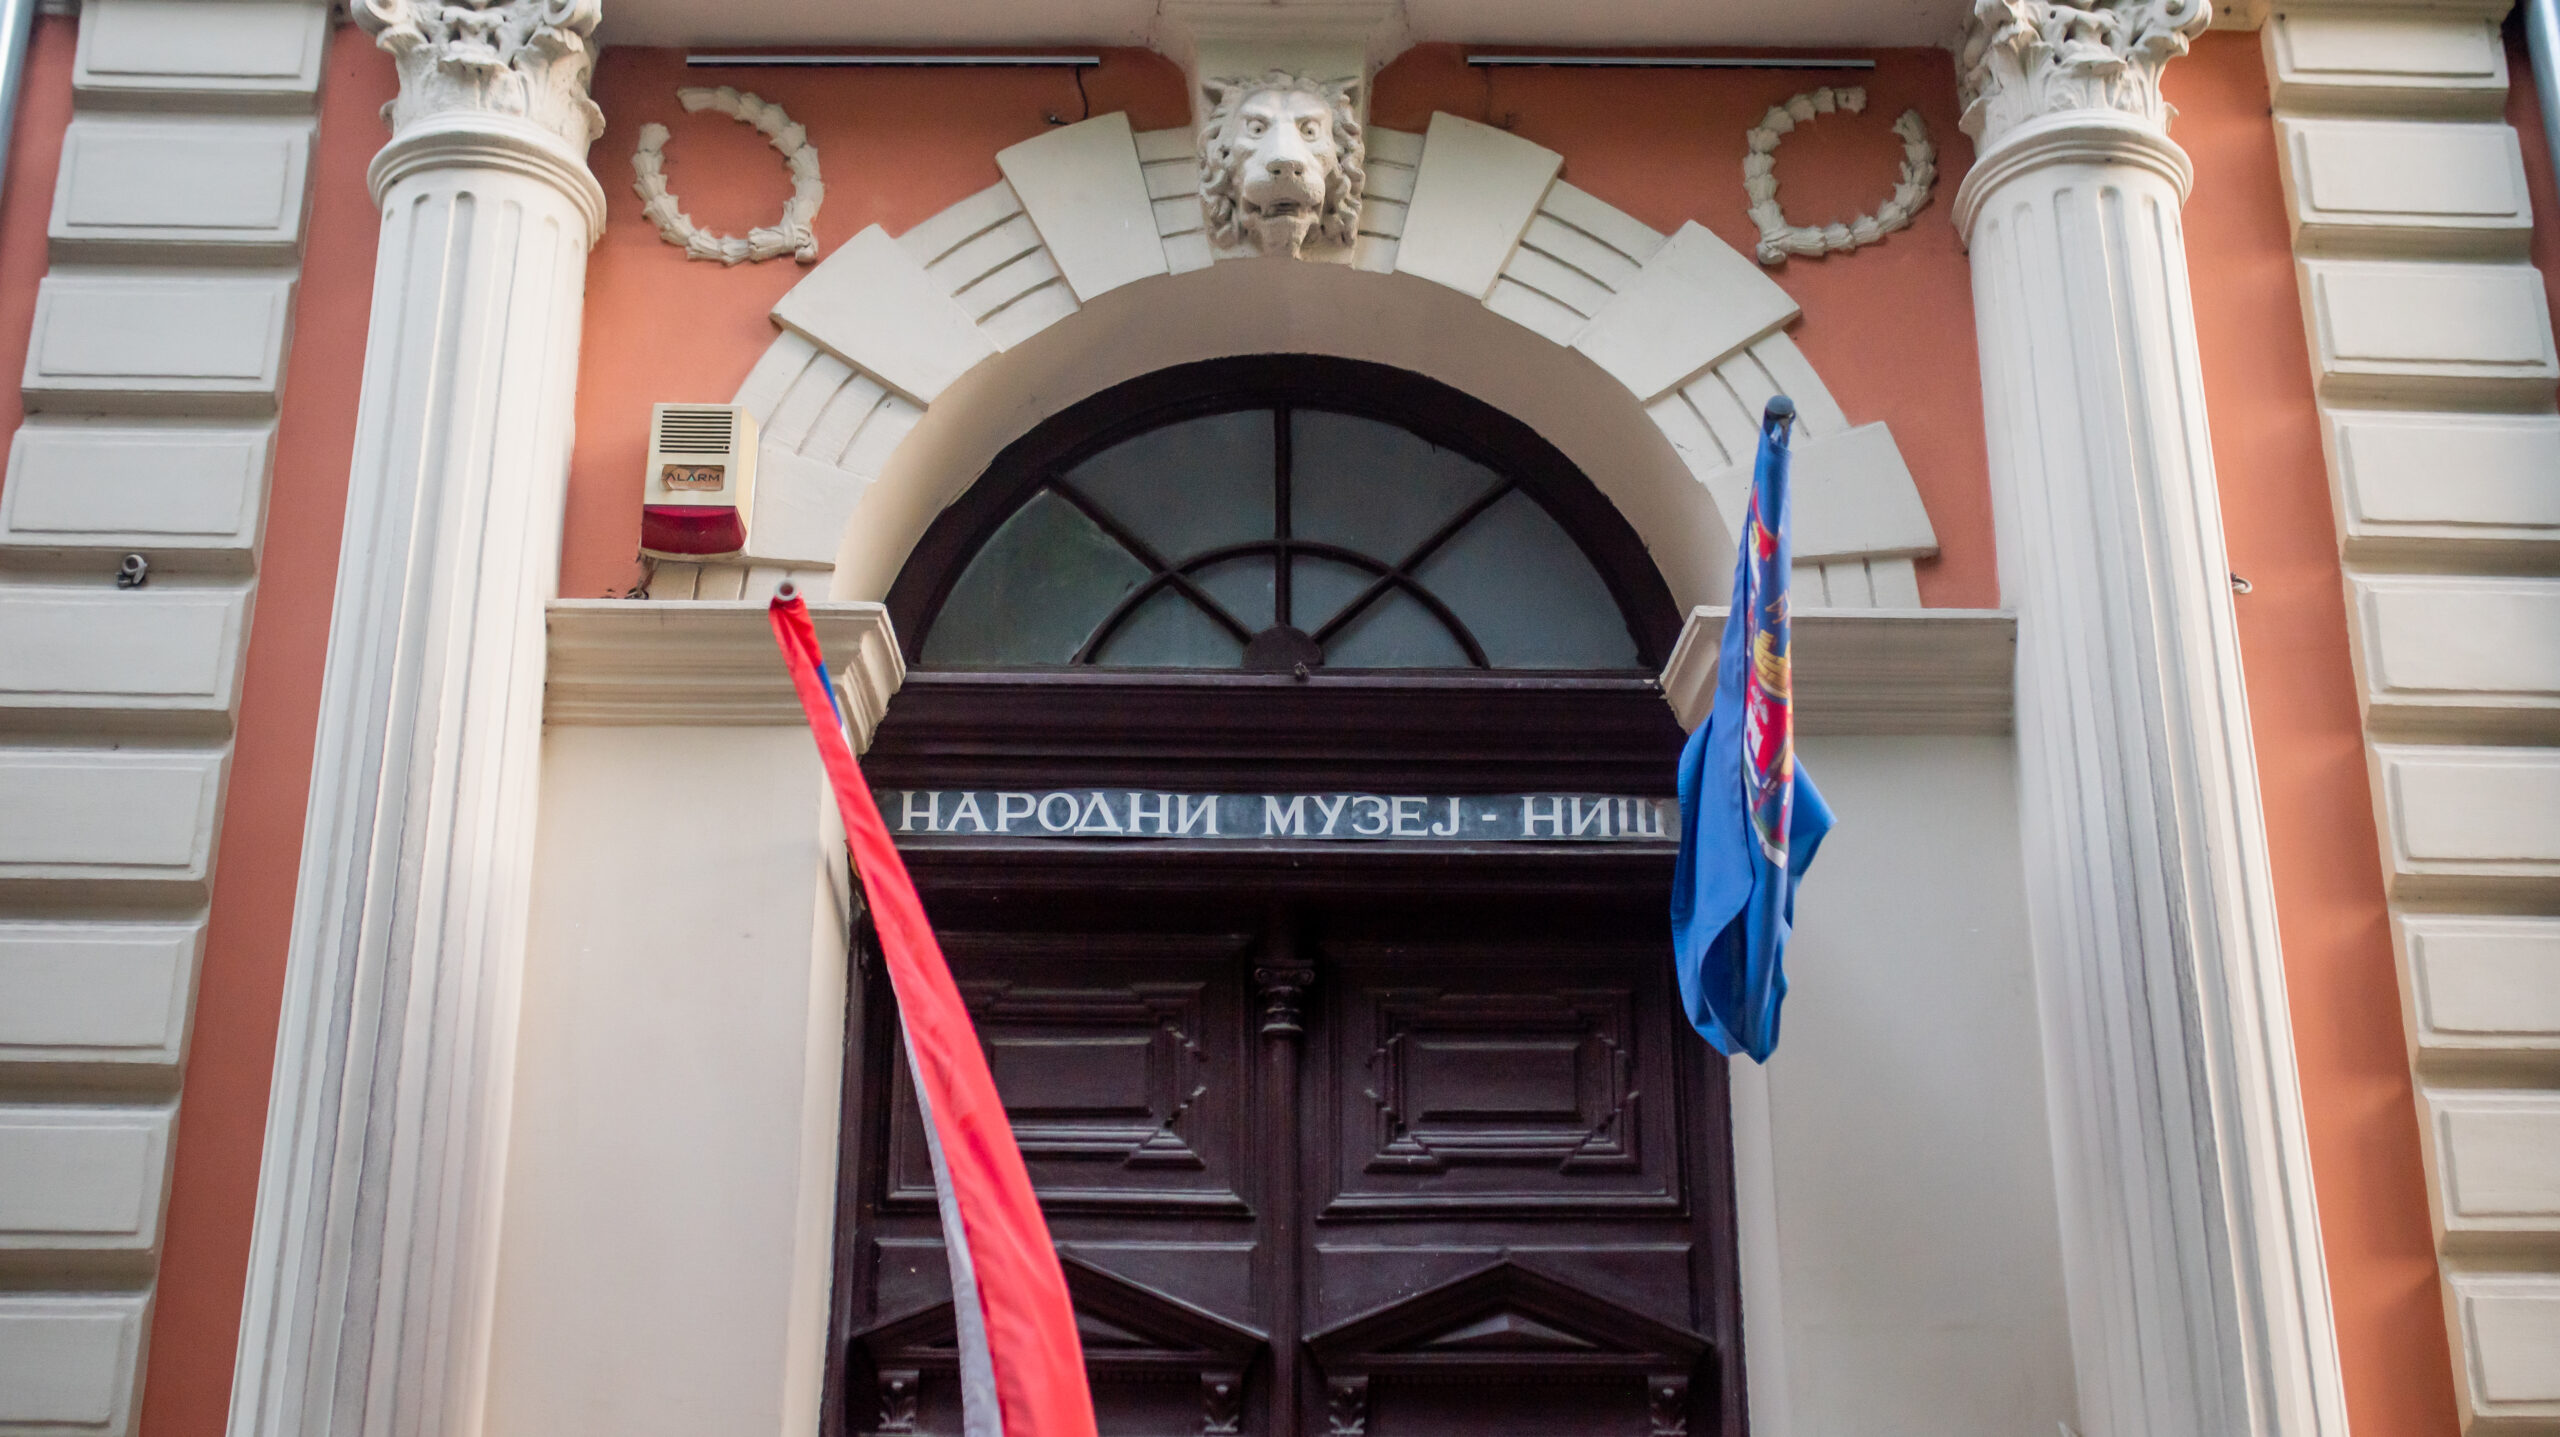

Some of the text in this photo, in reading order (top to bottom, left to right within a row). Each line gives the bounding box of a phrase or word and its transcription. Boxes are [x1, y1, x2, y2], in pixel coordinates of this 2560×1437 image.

[665, 472, 720, 482] ALARM
[897, 791, 1222, 836] НАРОДНИ
[1262, 794, 1461, 836] МУЗЕЈ
[1521, 796, 1667, 838] НИШ
